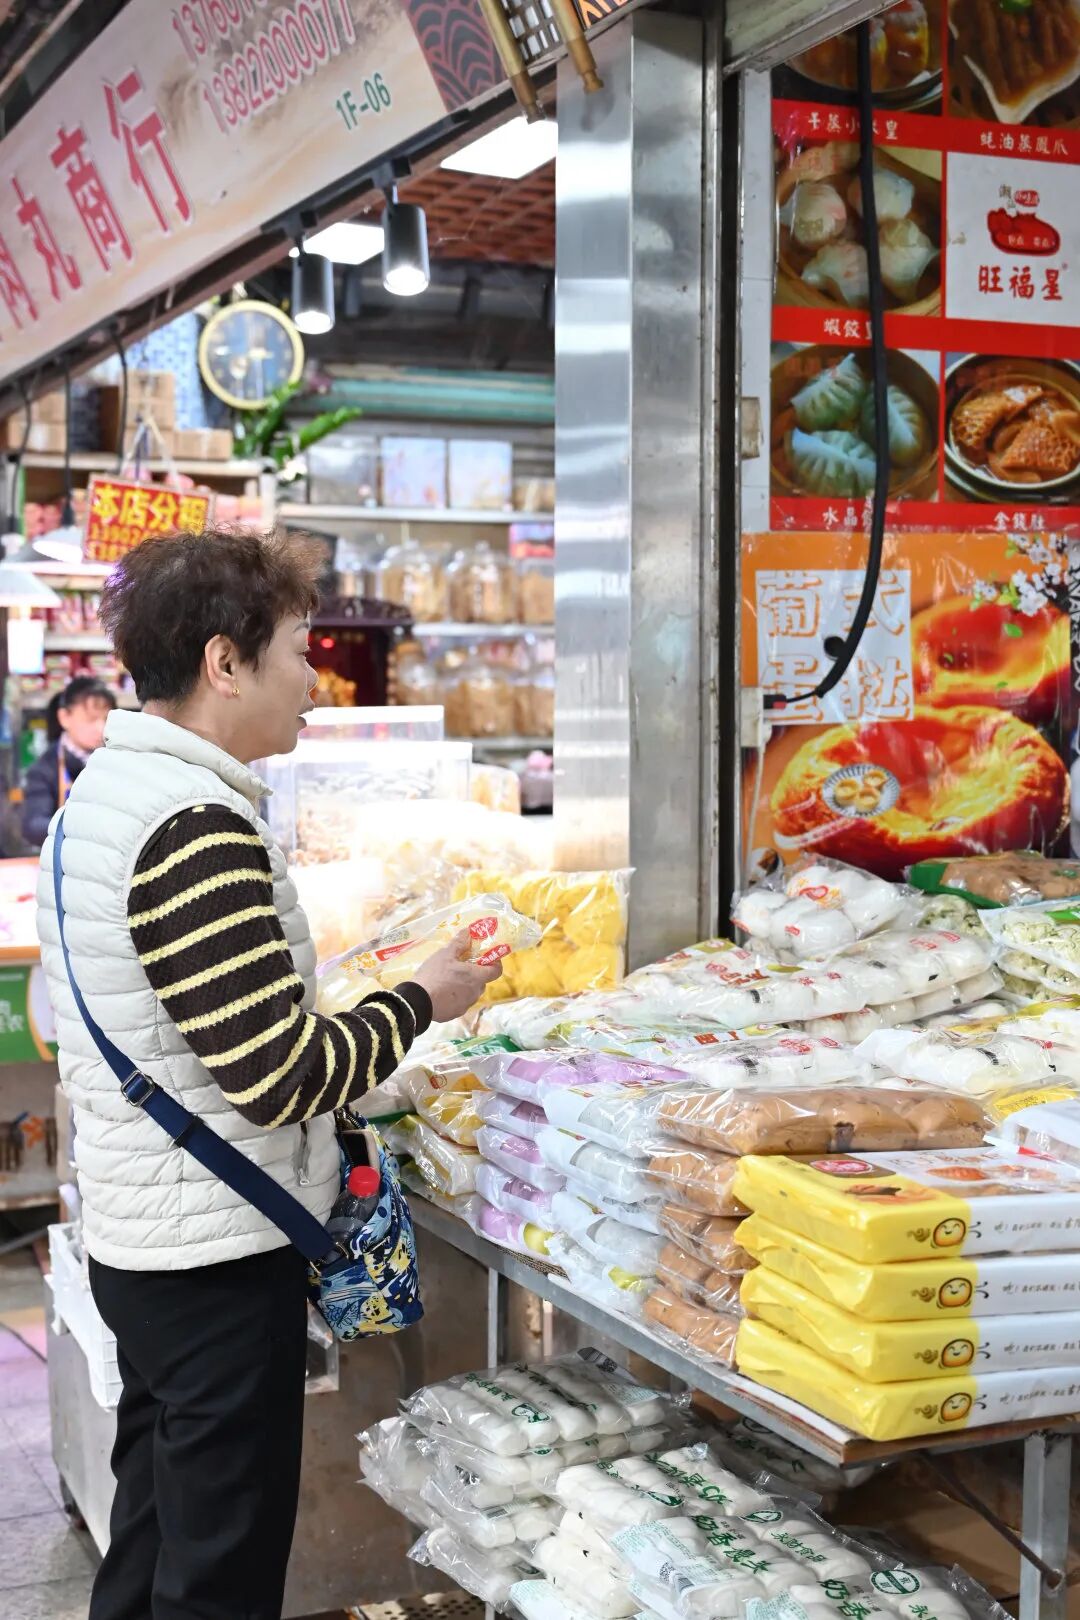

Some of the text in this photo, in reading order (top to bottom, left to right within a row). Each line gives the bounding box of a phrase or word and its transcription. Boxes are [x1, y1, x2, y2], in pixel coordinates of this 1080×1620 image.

[336, 72, 391, 130] 1F-06
[978, 265, 1063, 301] 旺福星
